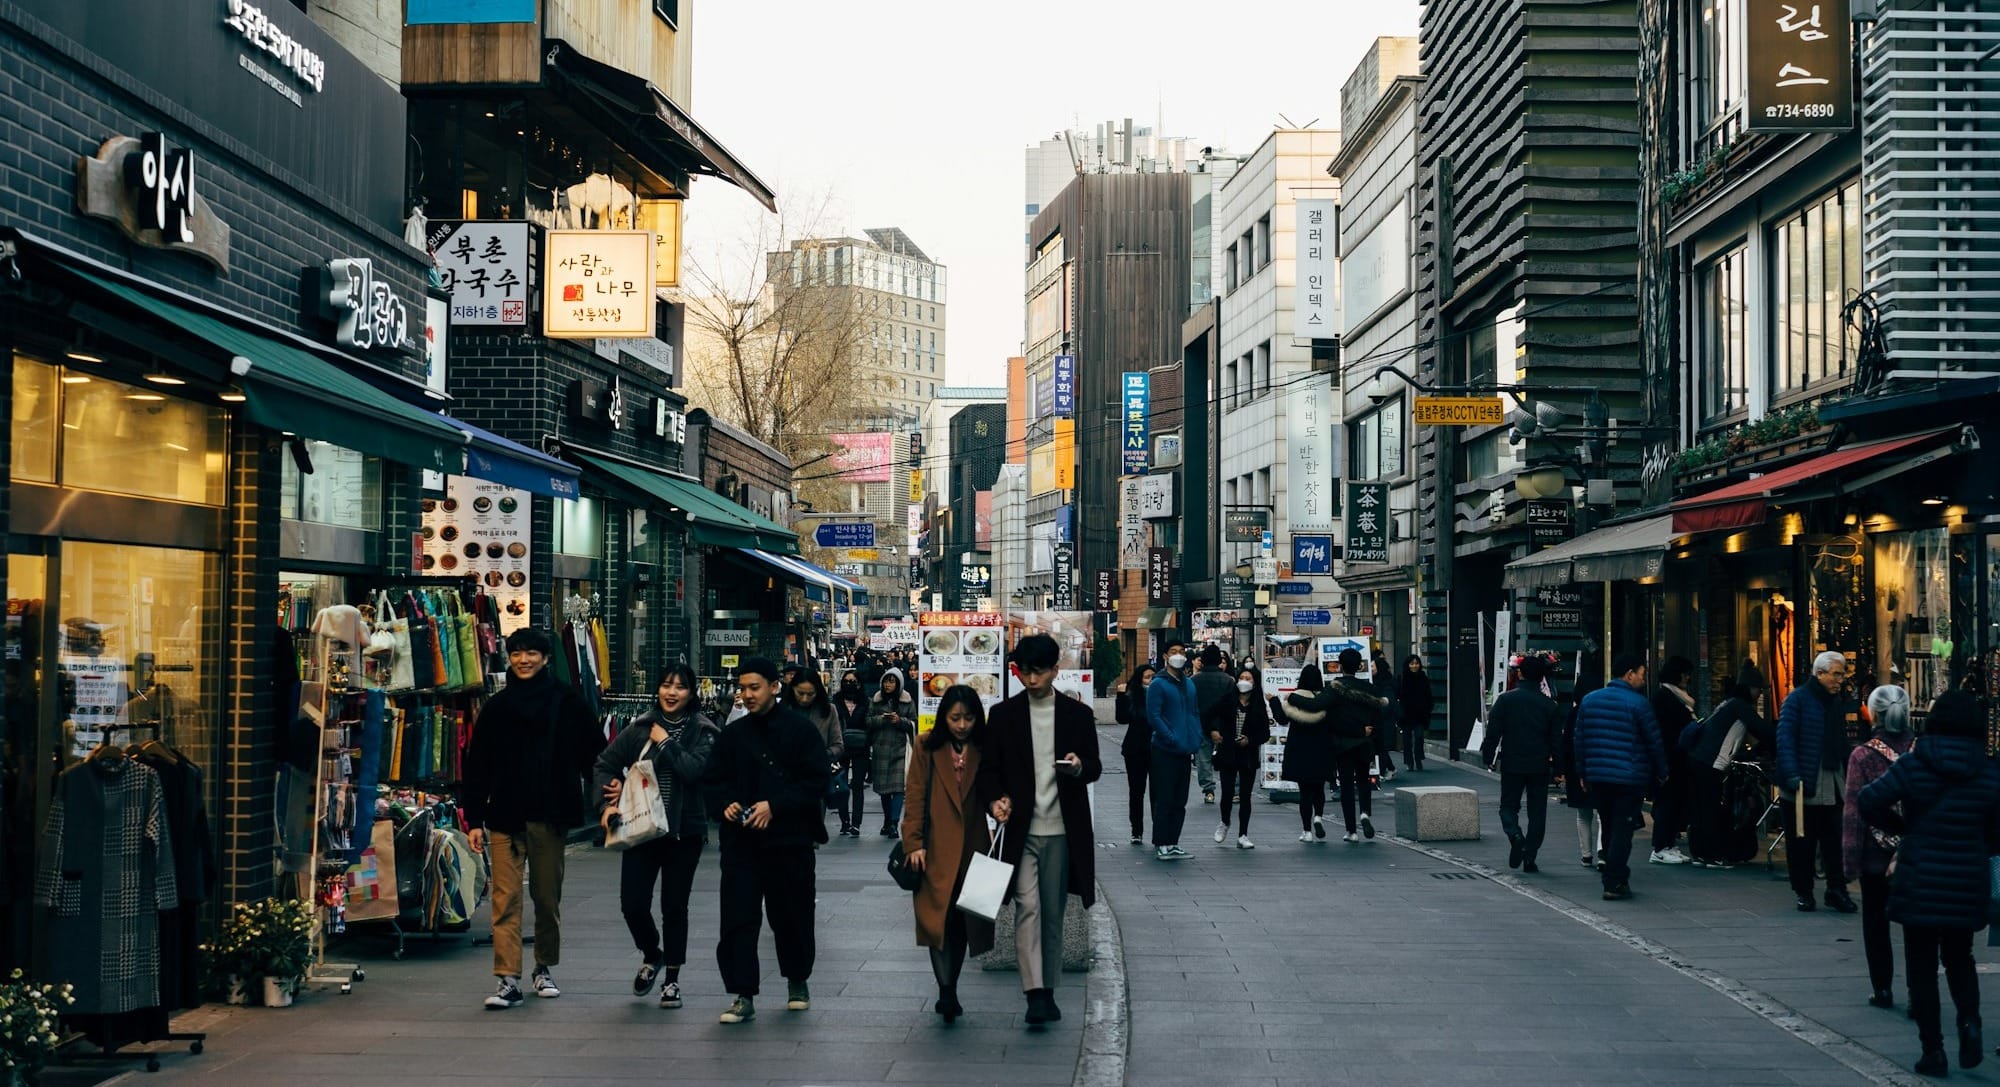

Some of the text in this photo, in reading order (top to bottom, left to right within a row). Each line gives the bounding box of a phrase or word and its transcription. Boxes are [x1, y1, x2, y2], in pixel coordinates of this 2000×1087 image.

[1777, 104, 1834, 117] 734-6890
[450, 236, 507, 264] 북촌
[1308, 209, 1323, 325] 갤러리 인덱스
[596, 281, 638, 298] 나무
[453, 306, 499, 319] 지하1층
[1300, 444, 1320, 475] 반한
[1304, 481, 1320, 515] 찻집
[1350, 537, 1384, 548] 다암
[1347, 550, 1386, 560] 739-8595
[724, 634, 749, 643] BANG
